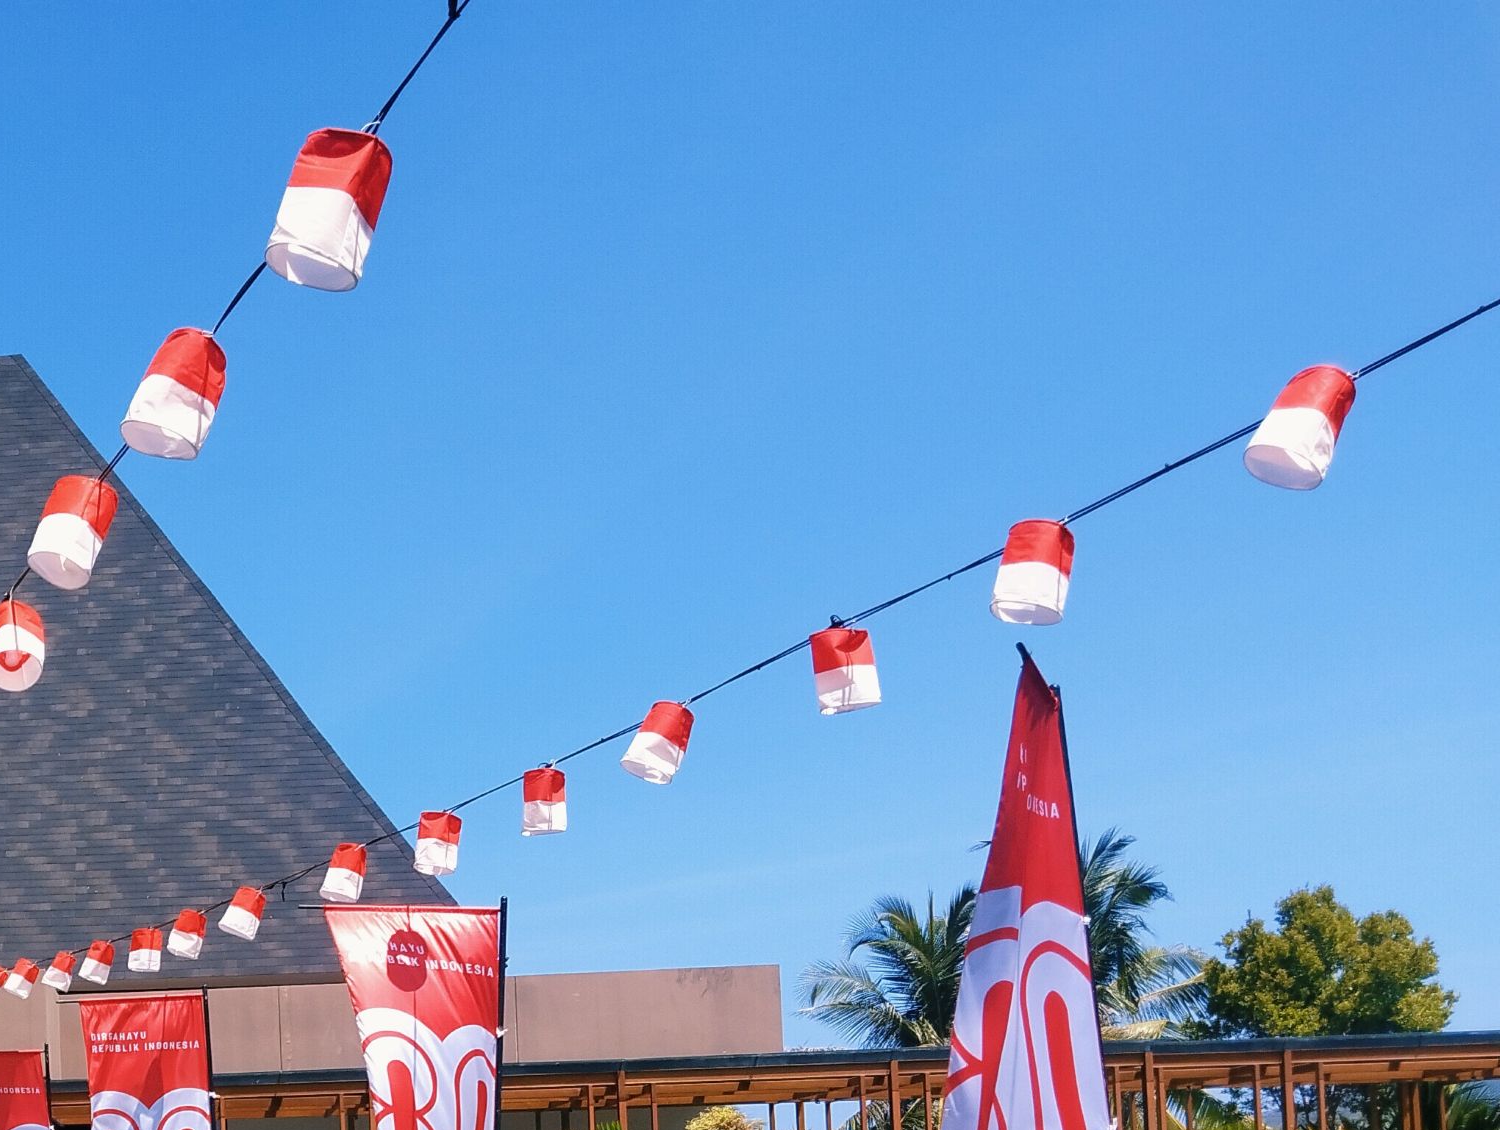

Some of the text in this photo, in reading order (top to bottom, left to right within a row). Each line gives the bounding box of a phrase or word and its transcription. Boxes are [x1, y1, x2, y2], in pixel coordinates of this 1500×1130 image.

[424, 959, 494, 978] INDONESIA
[90, 1031, 147, 1042] DIRGAHAYU
[91, 1040, 200, 1054] REPUBLIK INDONESIA
